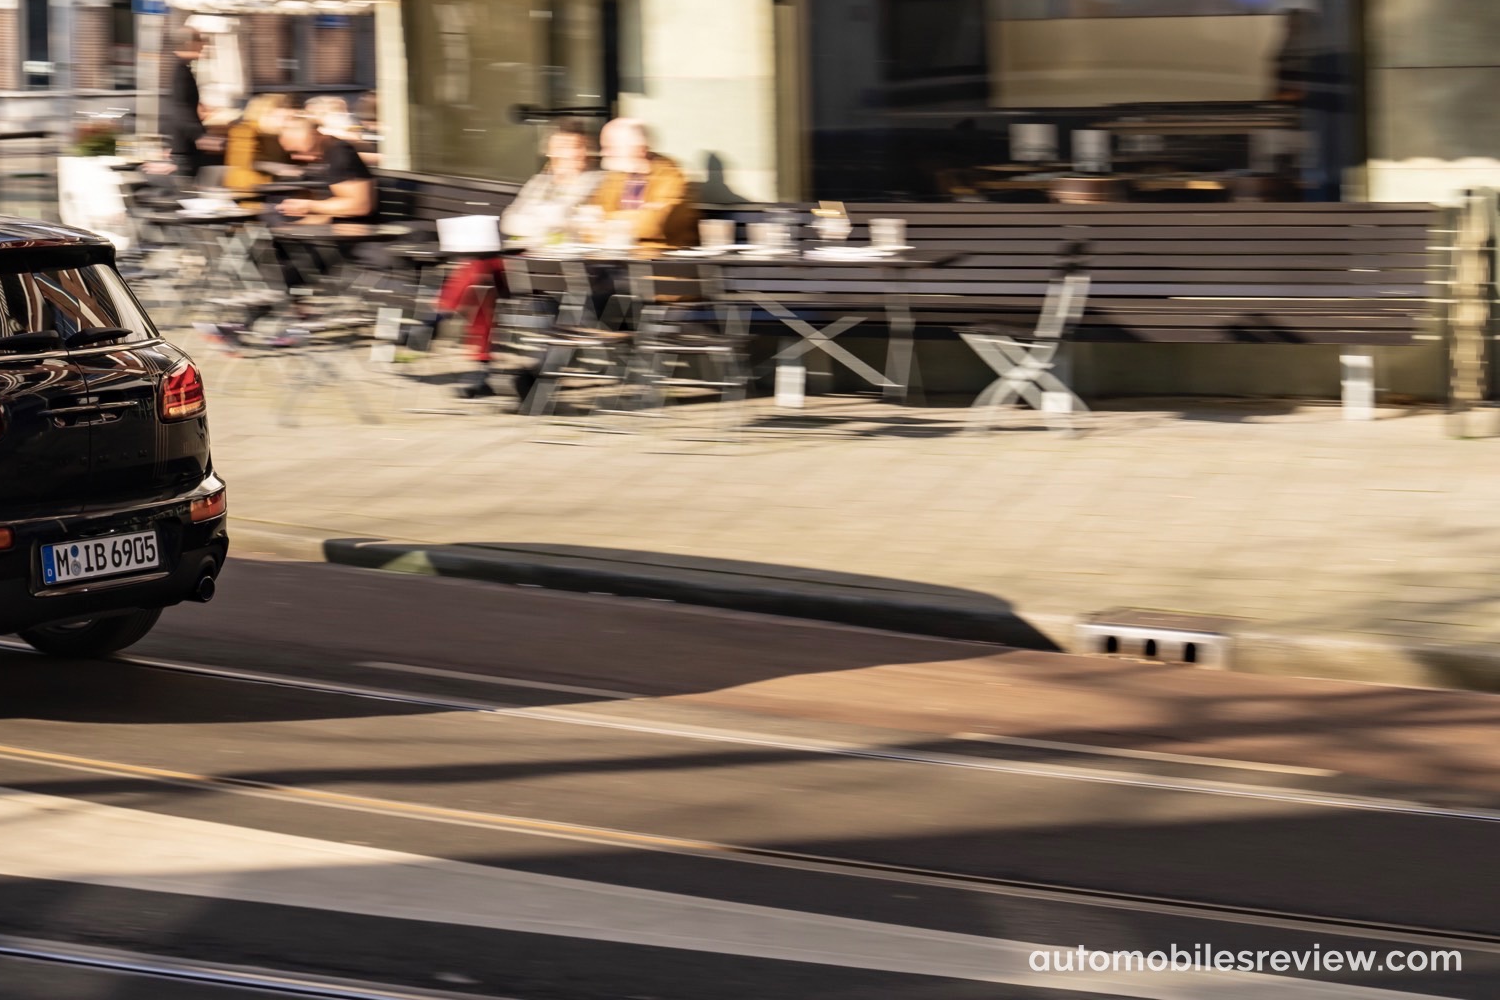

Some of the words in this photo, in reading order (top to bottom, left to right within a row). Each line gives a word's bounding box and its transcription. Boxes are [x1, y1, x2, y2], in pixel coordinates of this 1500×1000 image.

[55, 548, 70, 577] M
[84, 543, 107, 573] IB
[111, 535, 156, 568] 6905
